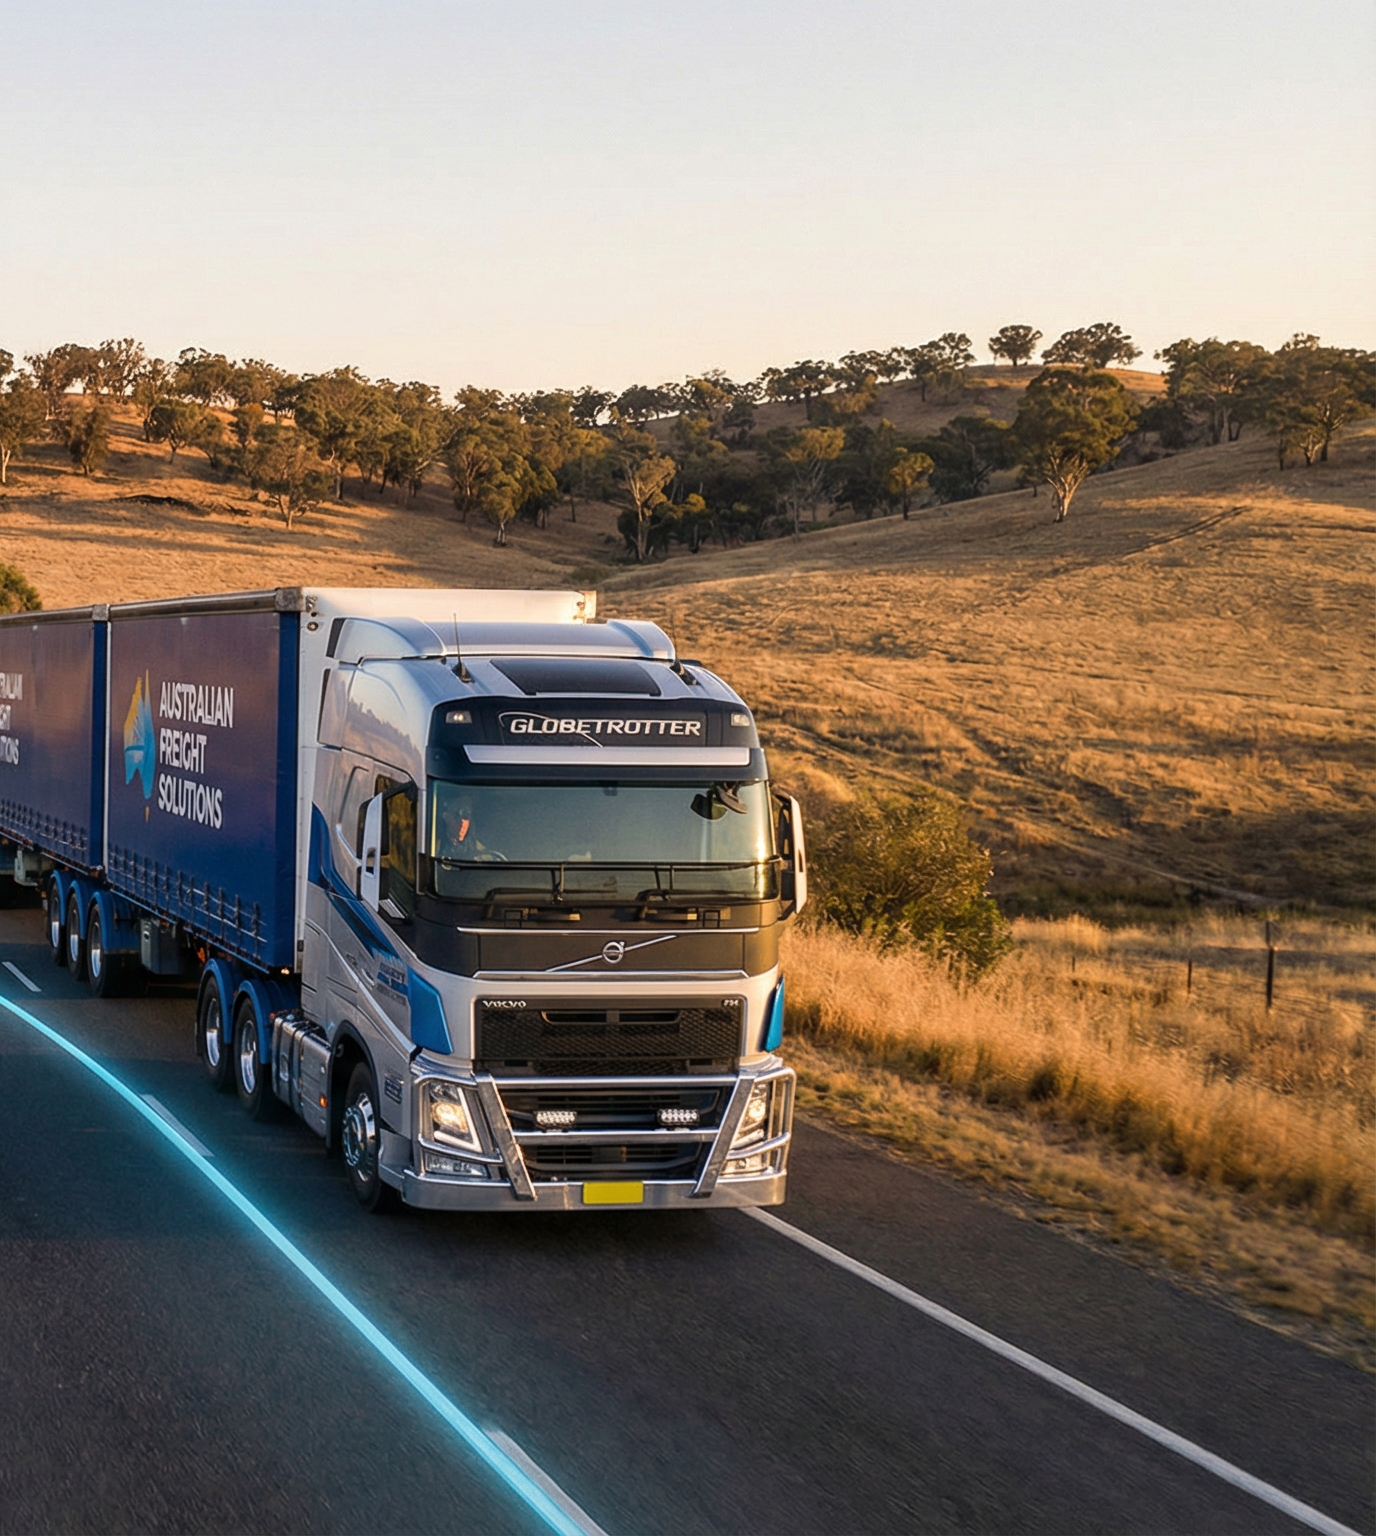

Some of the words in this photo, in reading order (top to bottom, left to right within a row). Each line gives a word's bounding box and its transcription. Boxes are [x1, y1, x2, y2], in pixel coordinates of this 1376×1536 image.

[159, 681, 234, 728] AUSTRALIAN
[509, 718, 702, 738] GLOBETROTTER
[159, 727, 207, 774] FREIGHT
[158, 773, 223, 829] SOLUTIONS
